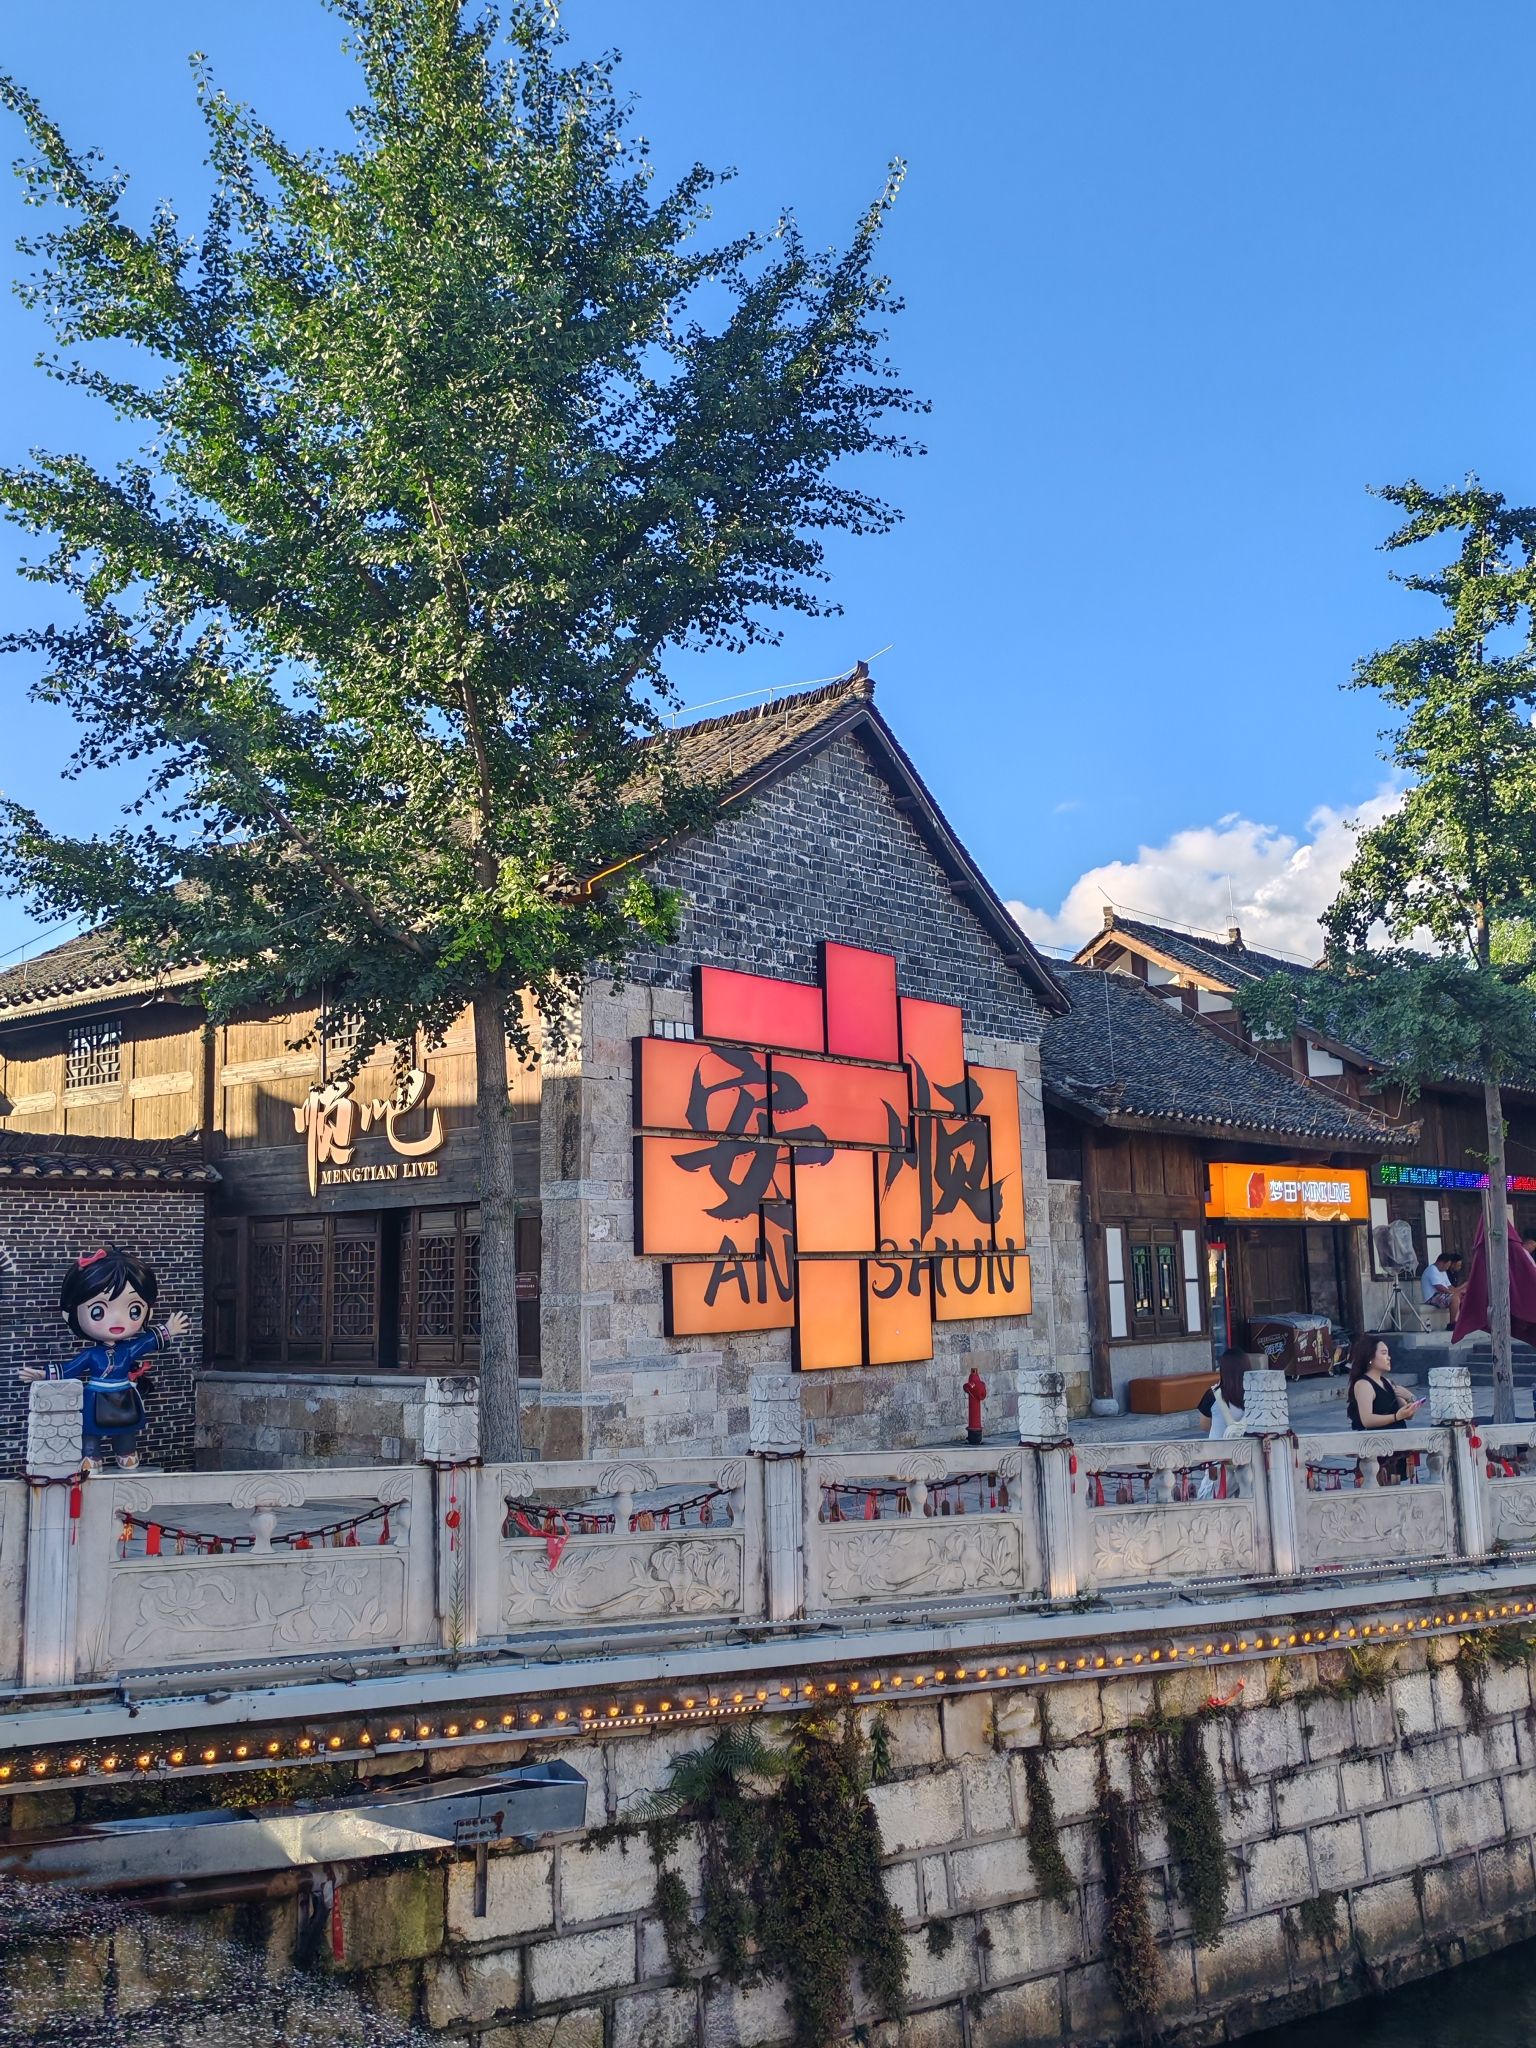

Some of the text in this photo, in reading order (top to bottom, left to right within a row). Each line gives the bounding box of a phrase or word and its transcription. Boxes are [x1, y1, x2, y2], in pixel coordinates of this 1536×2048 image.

[671, 1046, 1015, 1242] 安顺
[321, 1161, 438, 1185] MENGTIAN LIVE
[1270, 1180, 1297, 1203] 梦田
[704, 1235, 1015, 1307] AN SHUN
